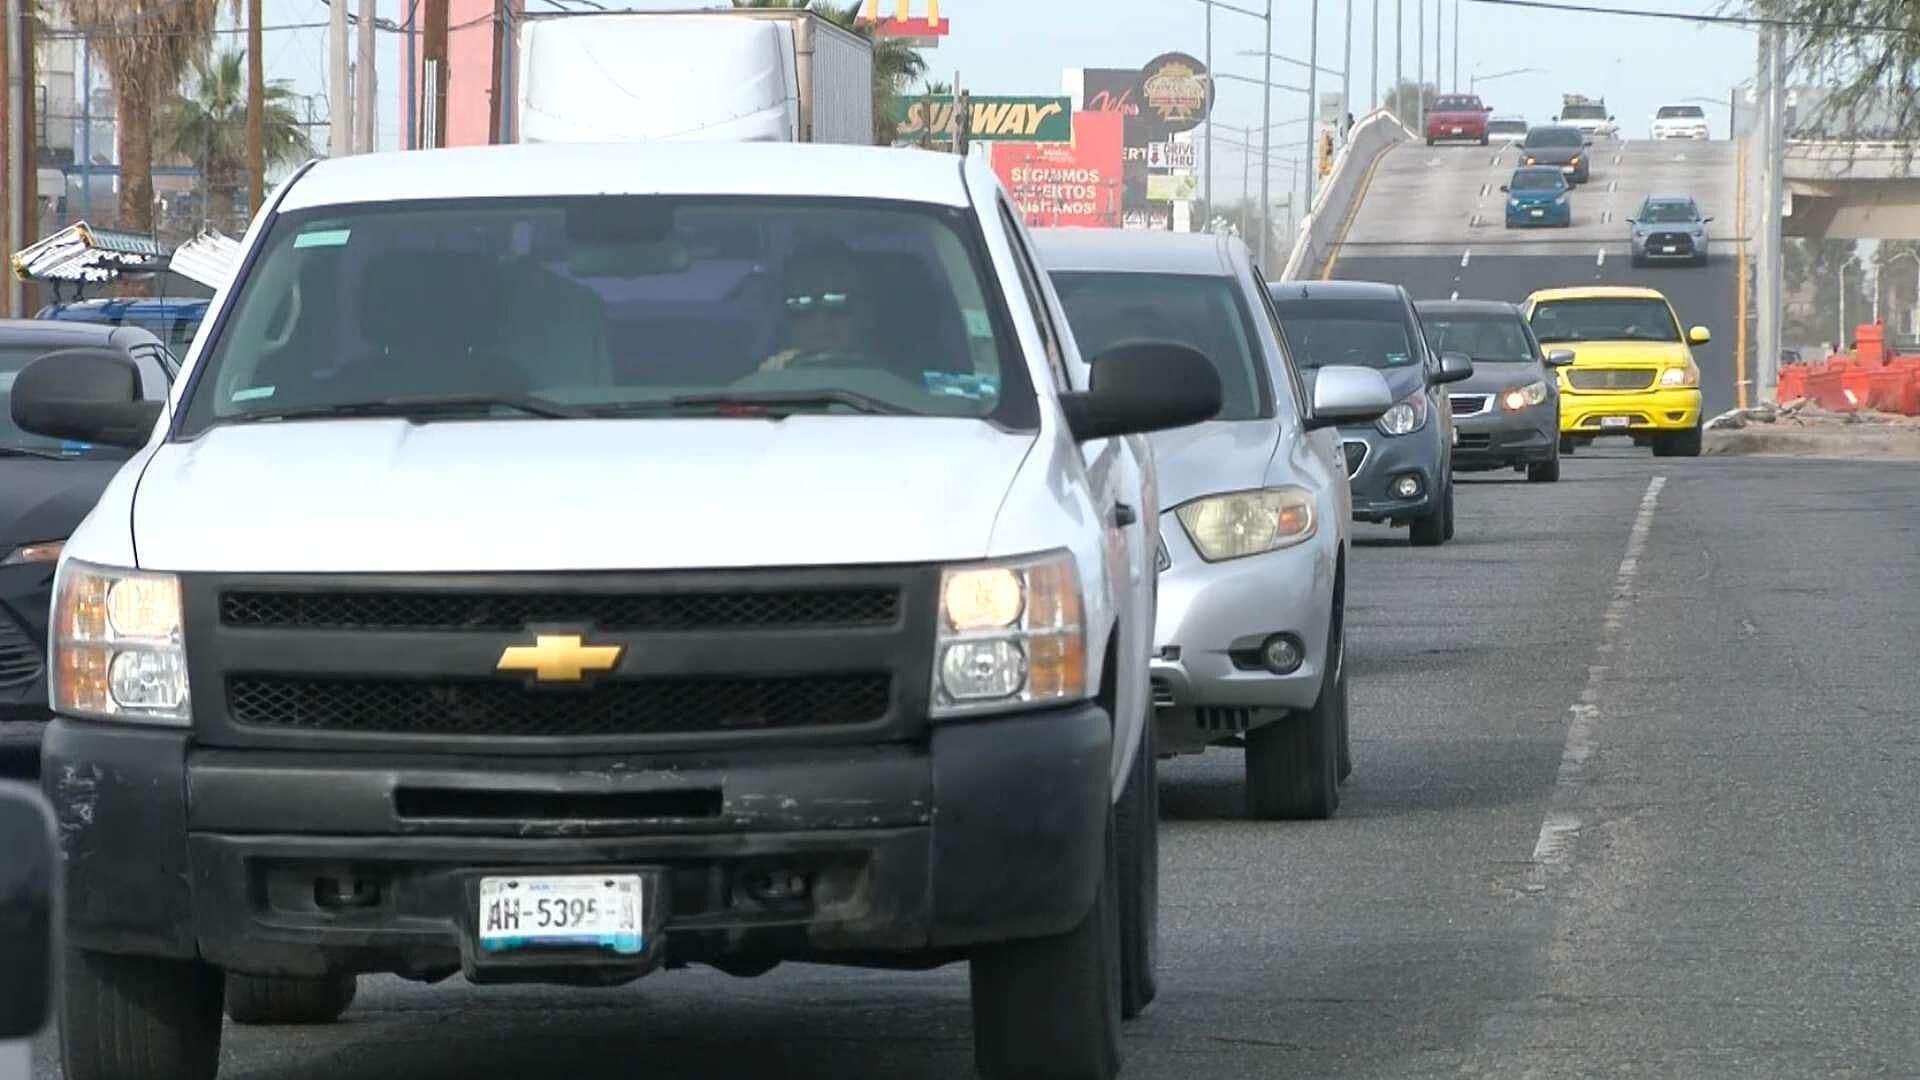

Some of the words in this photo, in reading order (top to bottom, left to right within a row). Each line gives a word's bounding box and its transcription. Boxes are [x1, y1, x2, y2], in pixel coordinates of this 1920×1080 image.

[897, 101, 1062, 135] SUWAY
[1164, 143, 1195, 155] DRIVE
[1165, 154, 1195, 166] THRU
[487, 895, 635, 931] AH-5395-
